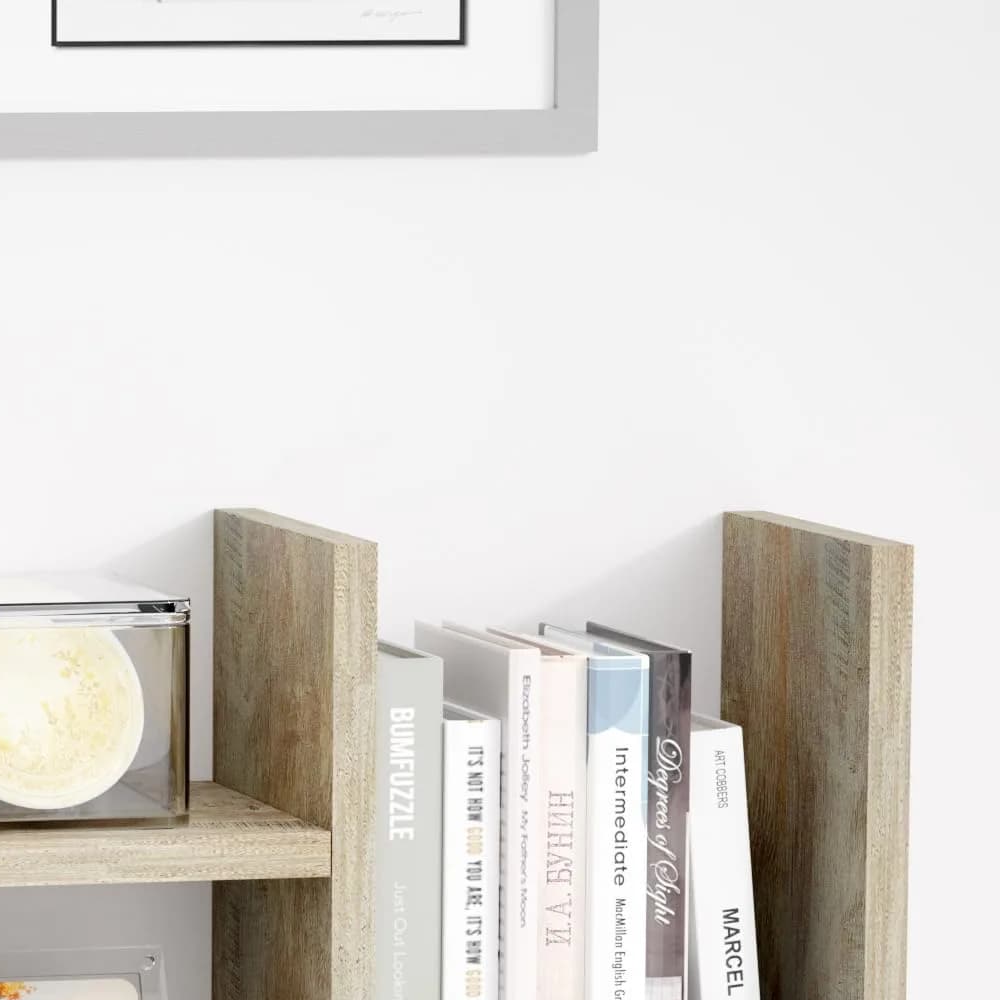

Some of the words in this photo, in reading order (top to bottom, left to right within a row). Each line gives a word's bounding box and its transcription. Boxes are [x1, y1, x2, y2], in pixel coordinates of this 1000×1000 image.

[522, 675, 531, 750] Elizabeth
[467, 746, 484, 767] IT'S
[715, 750, 724, 765] ART
[389, 707, 415, 840] BUMFUZZLE
[467, 772, 483, 792] NOT
[520, 754, 530, 802] Jolley
[646, 736, 683, 829] Degrees
[717, 768, 729, 809] COBBERS
[467, 798, 483, 822] HOW
[520, 810, 528, 831] My
[614, 748, 629, 886] Intermediate
[546, 791, 574, 885] БУНИН
[648, 833, 676, 854] of
[466, 860, 483, 881] YOU
[394, 882, 406, 912] Just
[645, 860, 678, 925] Sight
[394, 918, 407, 946] Out
[465, 916, 483, 936] IT'S
[615, 899, 627, 948] MacMillan
[465, 940, 482, 964] HOW
[722, 907, 744, 996] MARCEL
[612, 952, 627, 986] English
